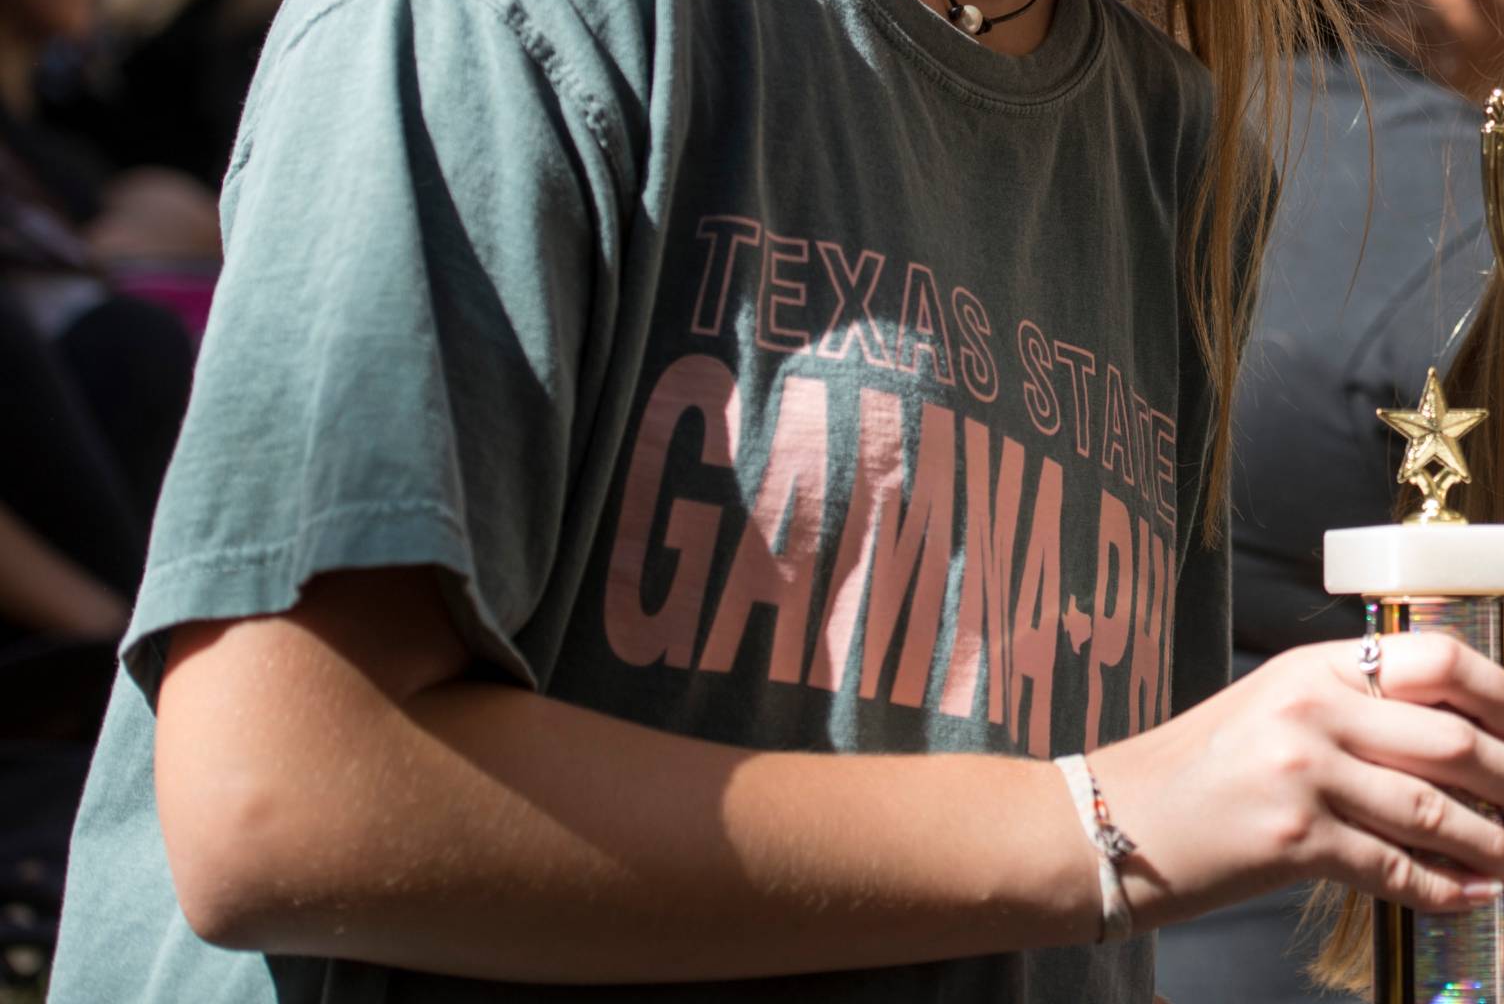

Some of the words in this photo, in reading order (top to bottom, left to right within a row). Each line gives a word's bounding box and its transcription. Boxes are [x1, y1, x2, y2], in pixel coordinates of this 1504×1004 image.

[691, 215, 998, 403] TEXAS
[1018, 320, 1177, 528] STATE
[603, 353, 1064, 759] GAMMA
[1084, 489, 1176, 756] PHI
